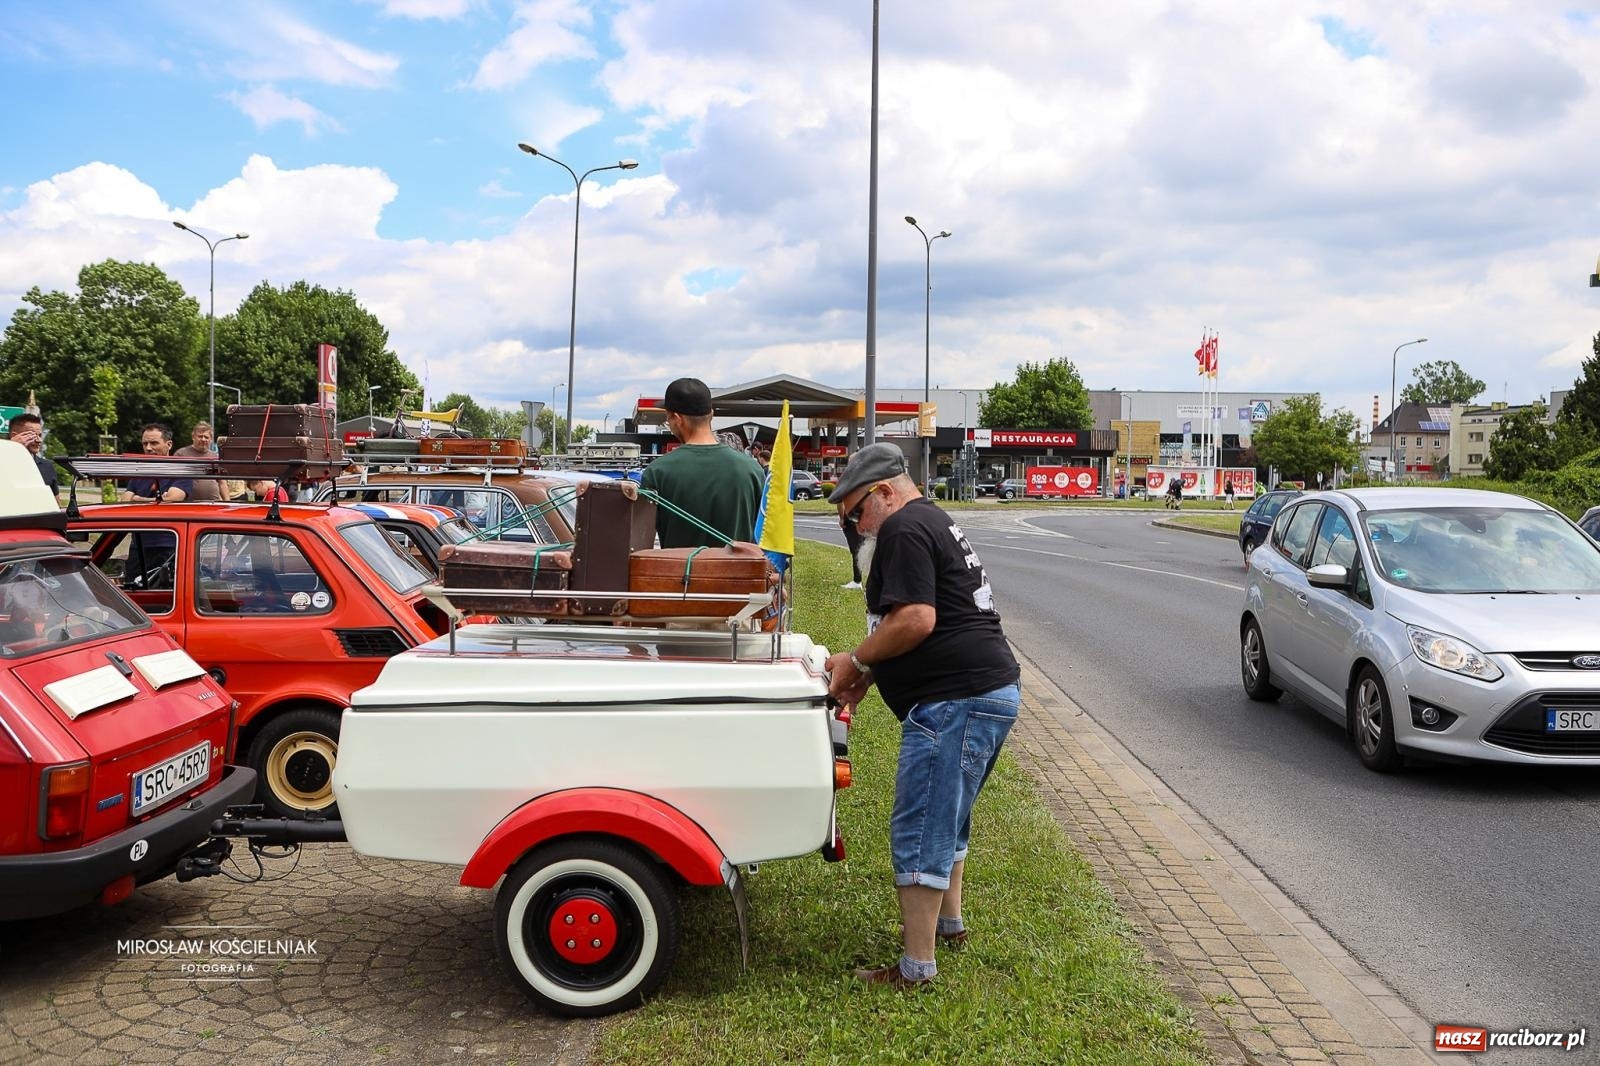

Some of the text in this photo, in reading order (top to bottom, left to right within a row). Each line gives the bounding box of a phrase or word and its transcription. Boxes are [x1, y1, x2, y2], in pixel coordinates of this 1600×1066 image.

[993, 435, 1074, 444] RESTAURACJA
[1581, 655, 1600, 665] Ford
[1559, 712, 1593, 728] SRC
[144, 748, 207, 801] SRC 45R9
[133, 842, 145, 859] PL
